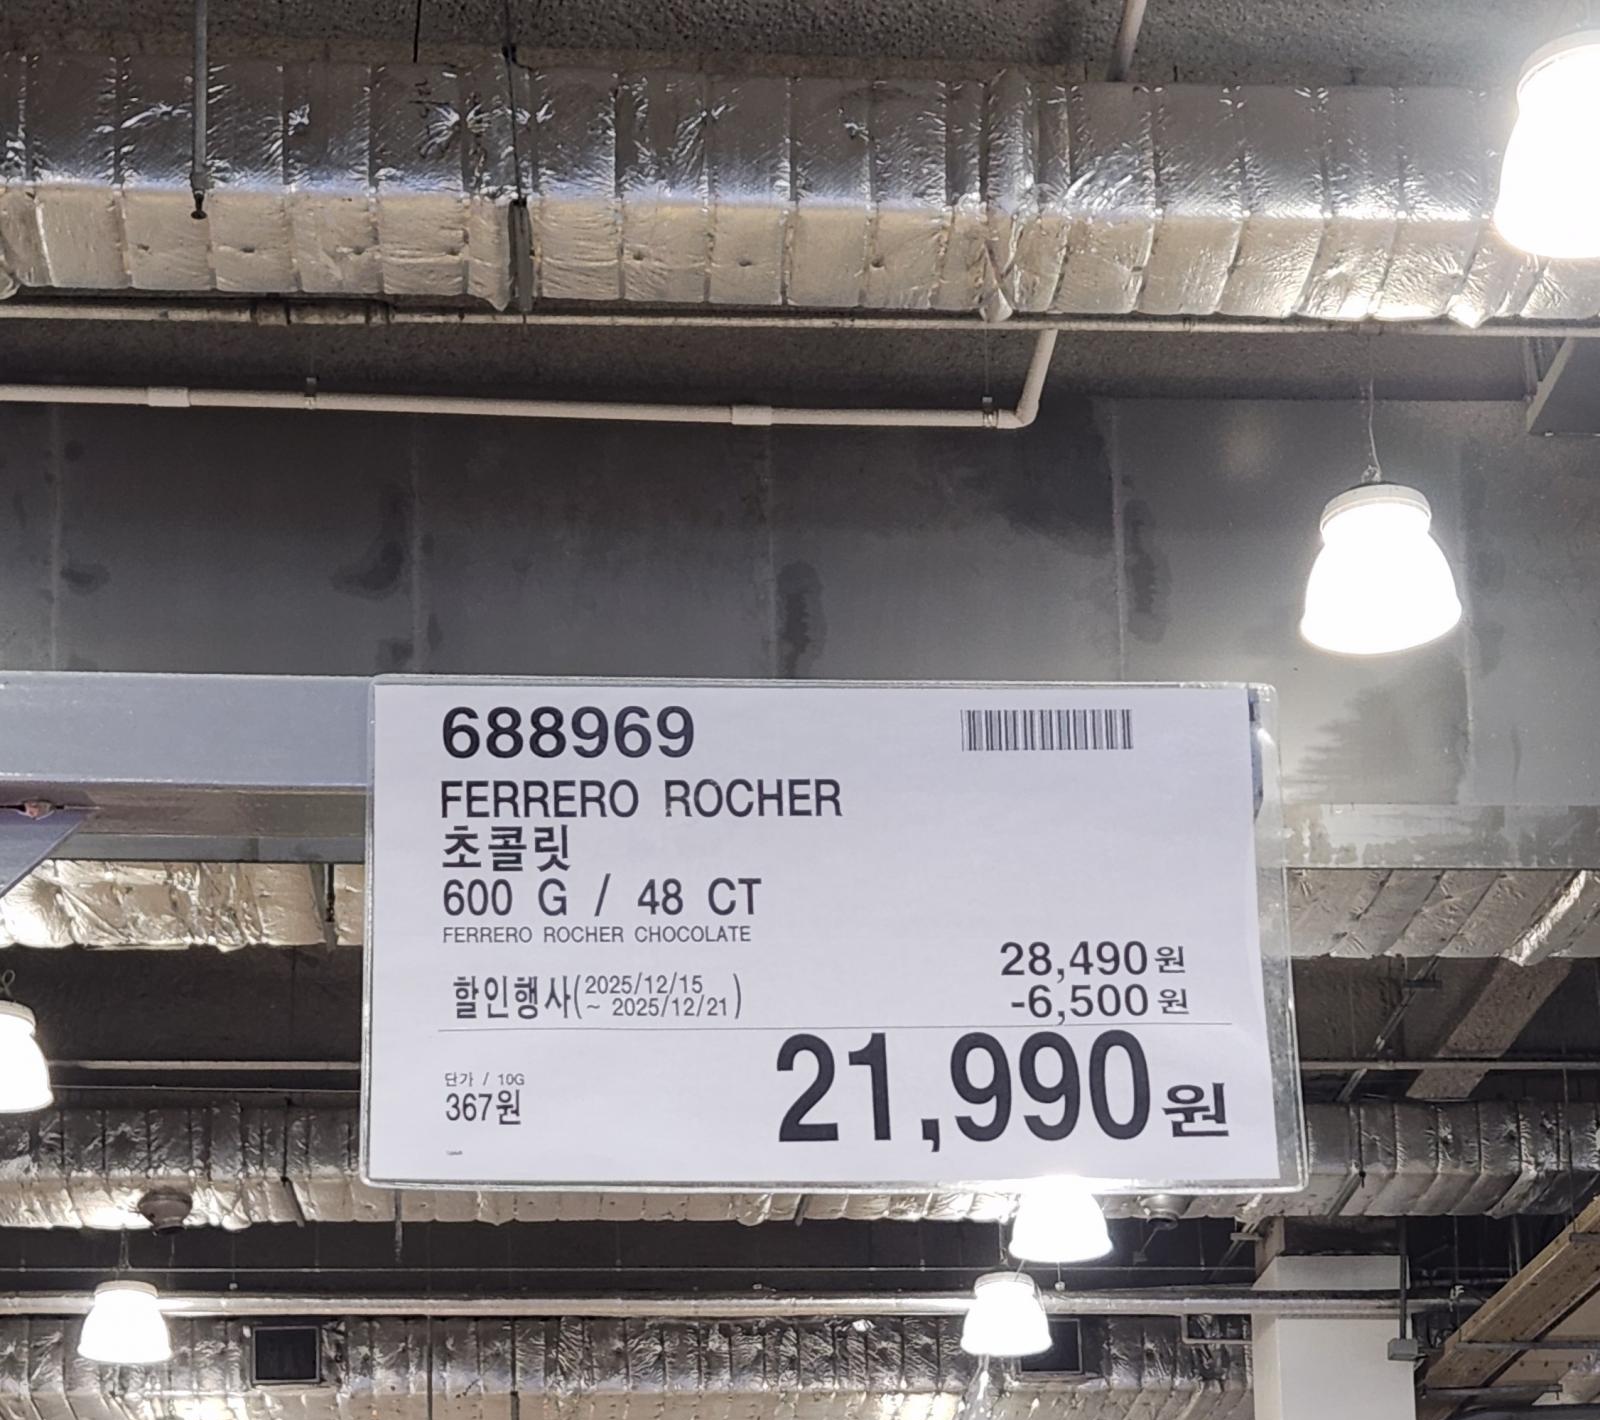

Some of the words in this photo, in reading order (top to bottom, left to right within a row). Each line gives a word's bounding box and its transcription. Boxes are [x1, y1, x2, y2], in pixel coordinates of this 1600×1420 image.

[442, 705, 695, 760] 688969
[440, 778, 640, 819] FERRERO
[664, 777, 843, 818] ROCHER
[442, 823, 571, 873] 초콜릿
[443, 878, 513, 917] 600
[537, 877, 568, 917] G
[594, 872, 612, 918] /
[637, 877, 684, 916] 48
[707, 877, 763, 917] CT
[443, 926, 533, 944] FERRERO
[543, 926, 624, 944] ROCHER
[634, 925, 752, 943] CHOCOLATE
[444, 1071, 474, 1087] 단가
[497, 1073, 525, 1086] 10G
